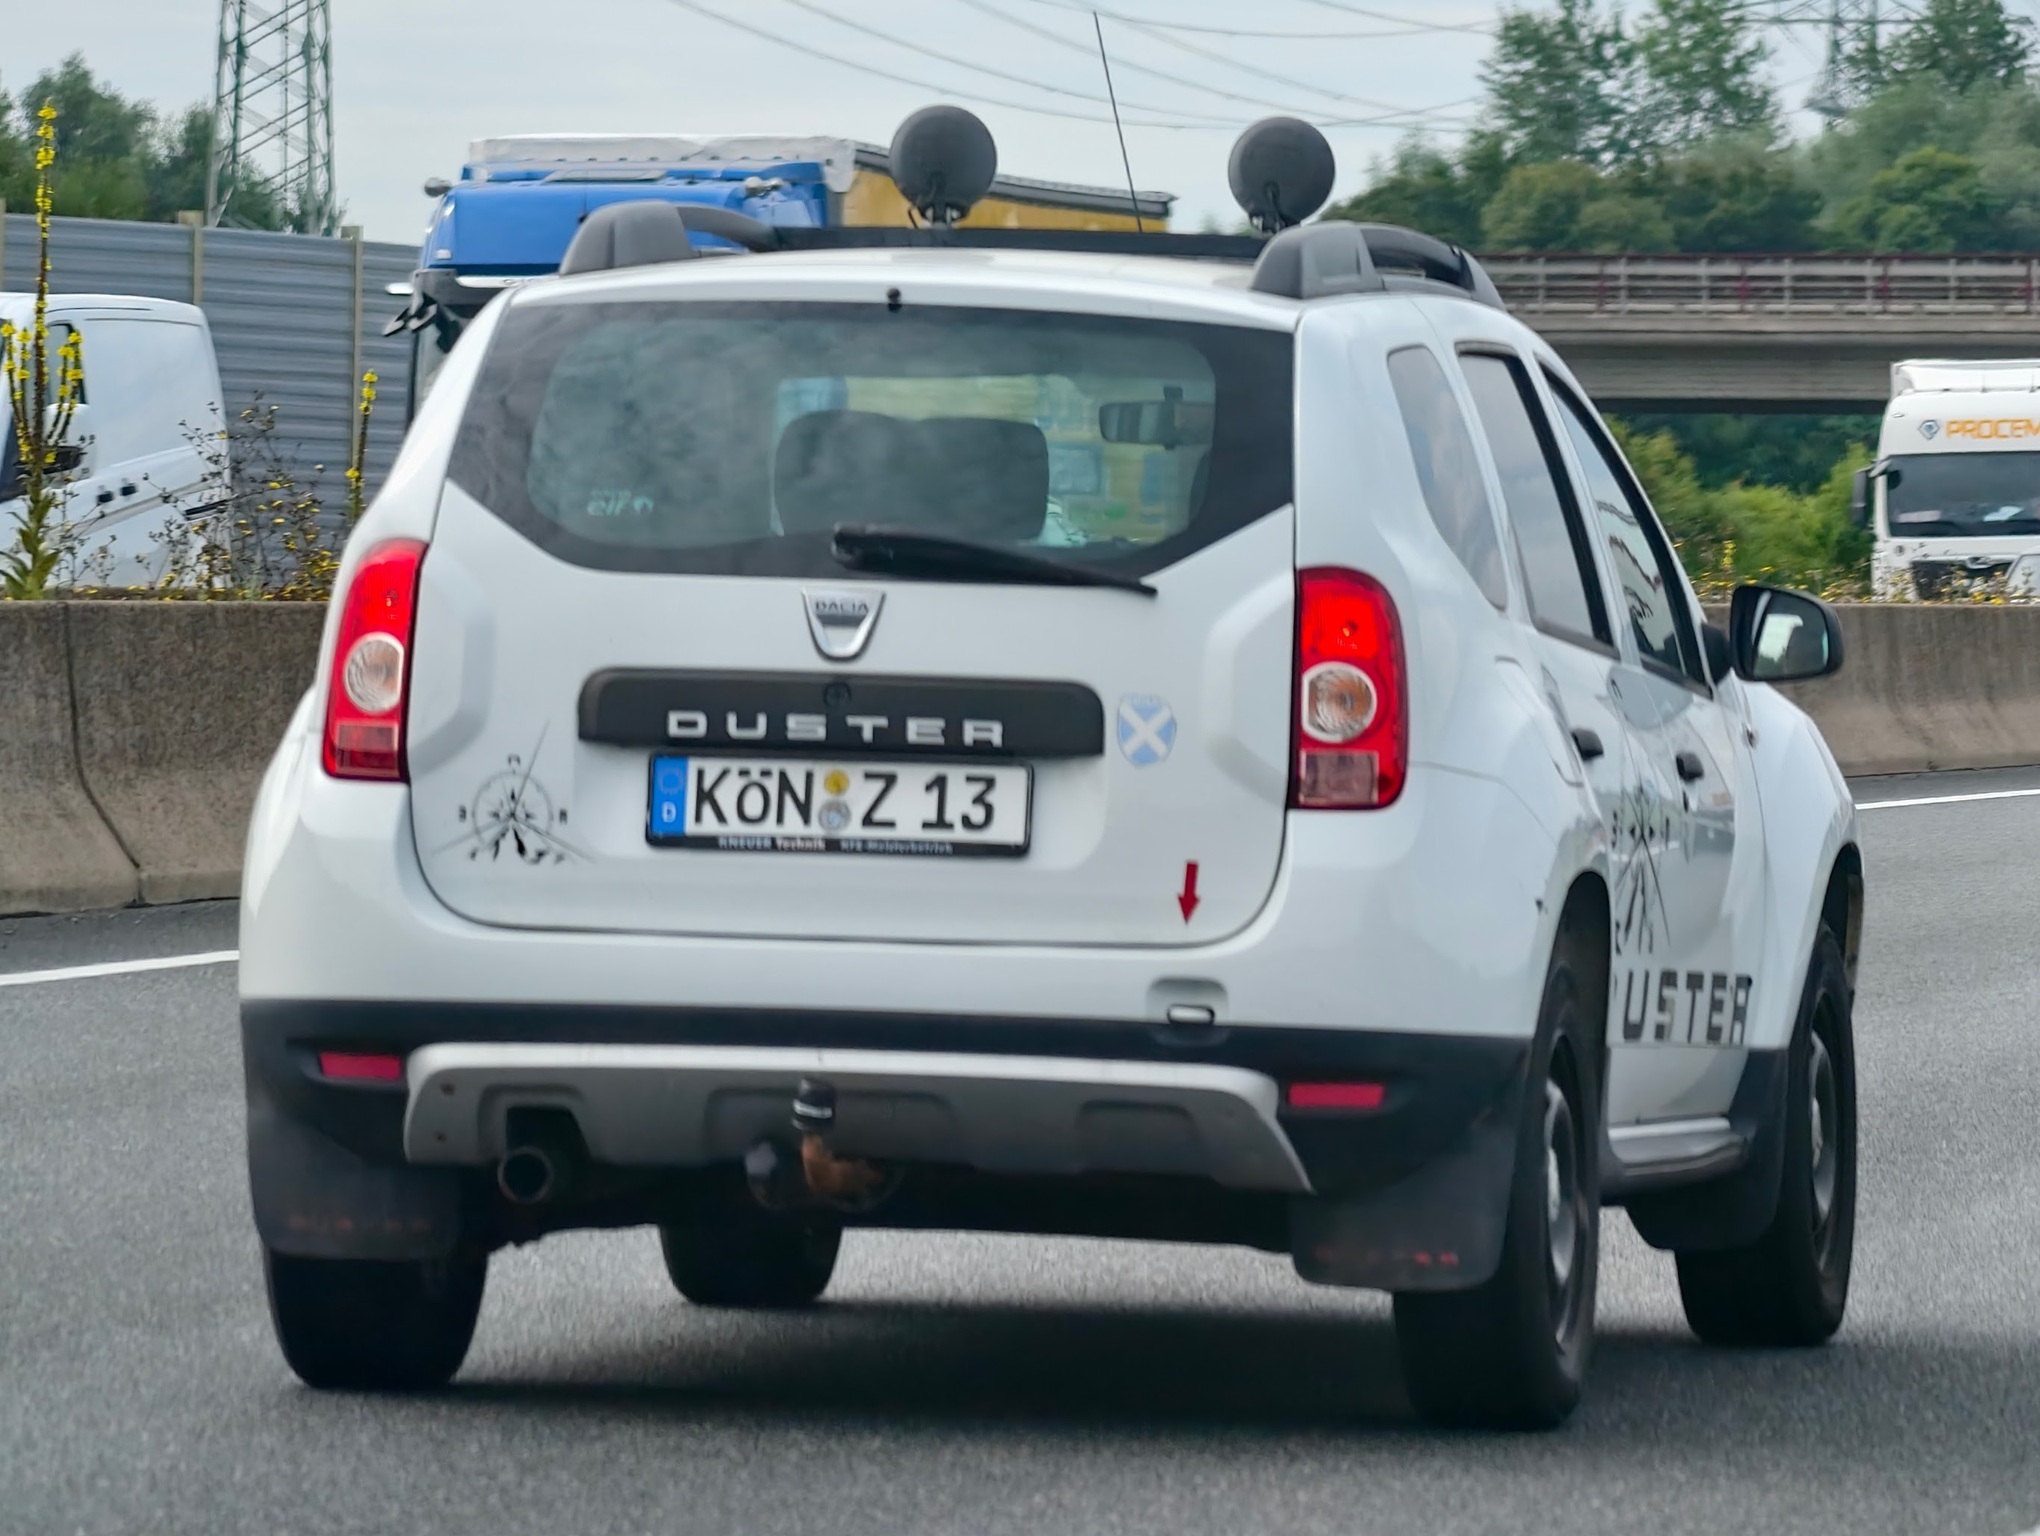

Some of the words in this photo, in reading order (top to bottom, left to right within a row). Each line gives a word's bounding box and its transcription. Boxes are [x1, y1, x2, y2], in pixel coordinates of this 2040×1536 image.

[667, 710, 1003, 748] DUSTER
[661, 802, 676, 823] D
[694, 767, 814, 826] KÖN
[862, 771, 898, 829] Z
[921, 773, 997, 831] 13
[1614, 968, 1752, 1045] USTER
